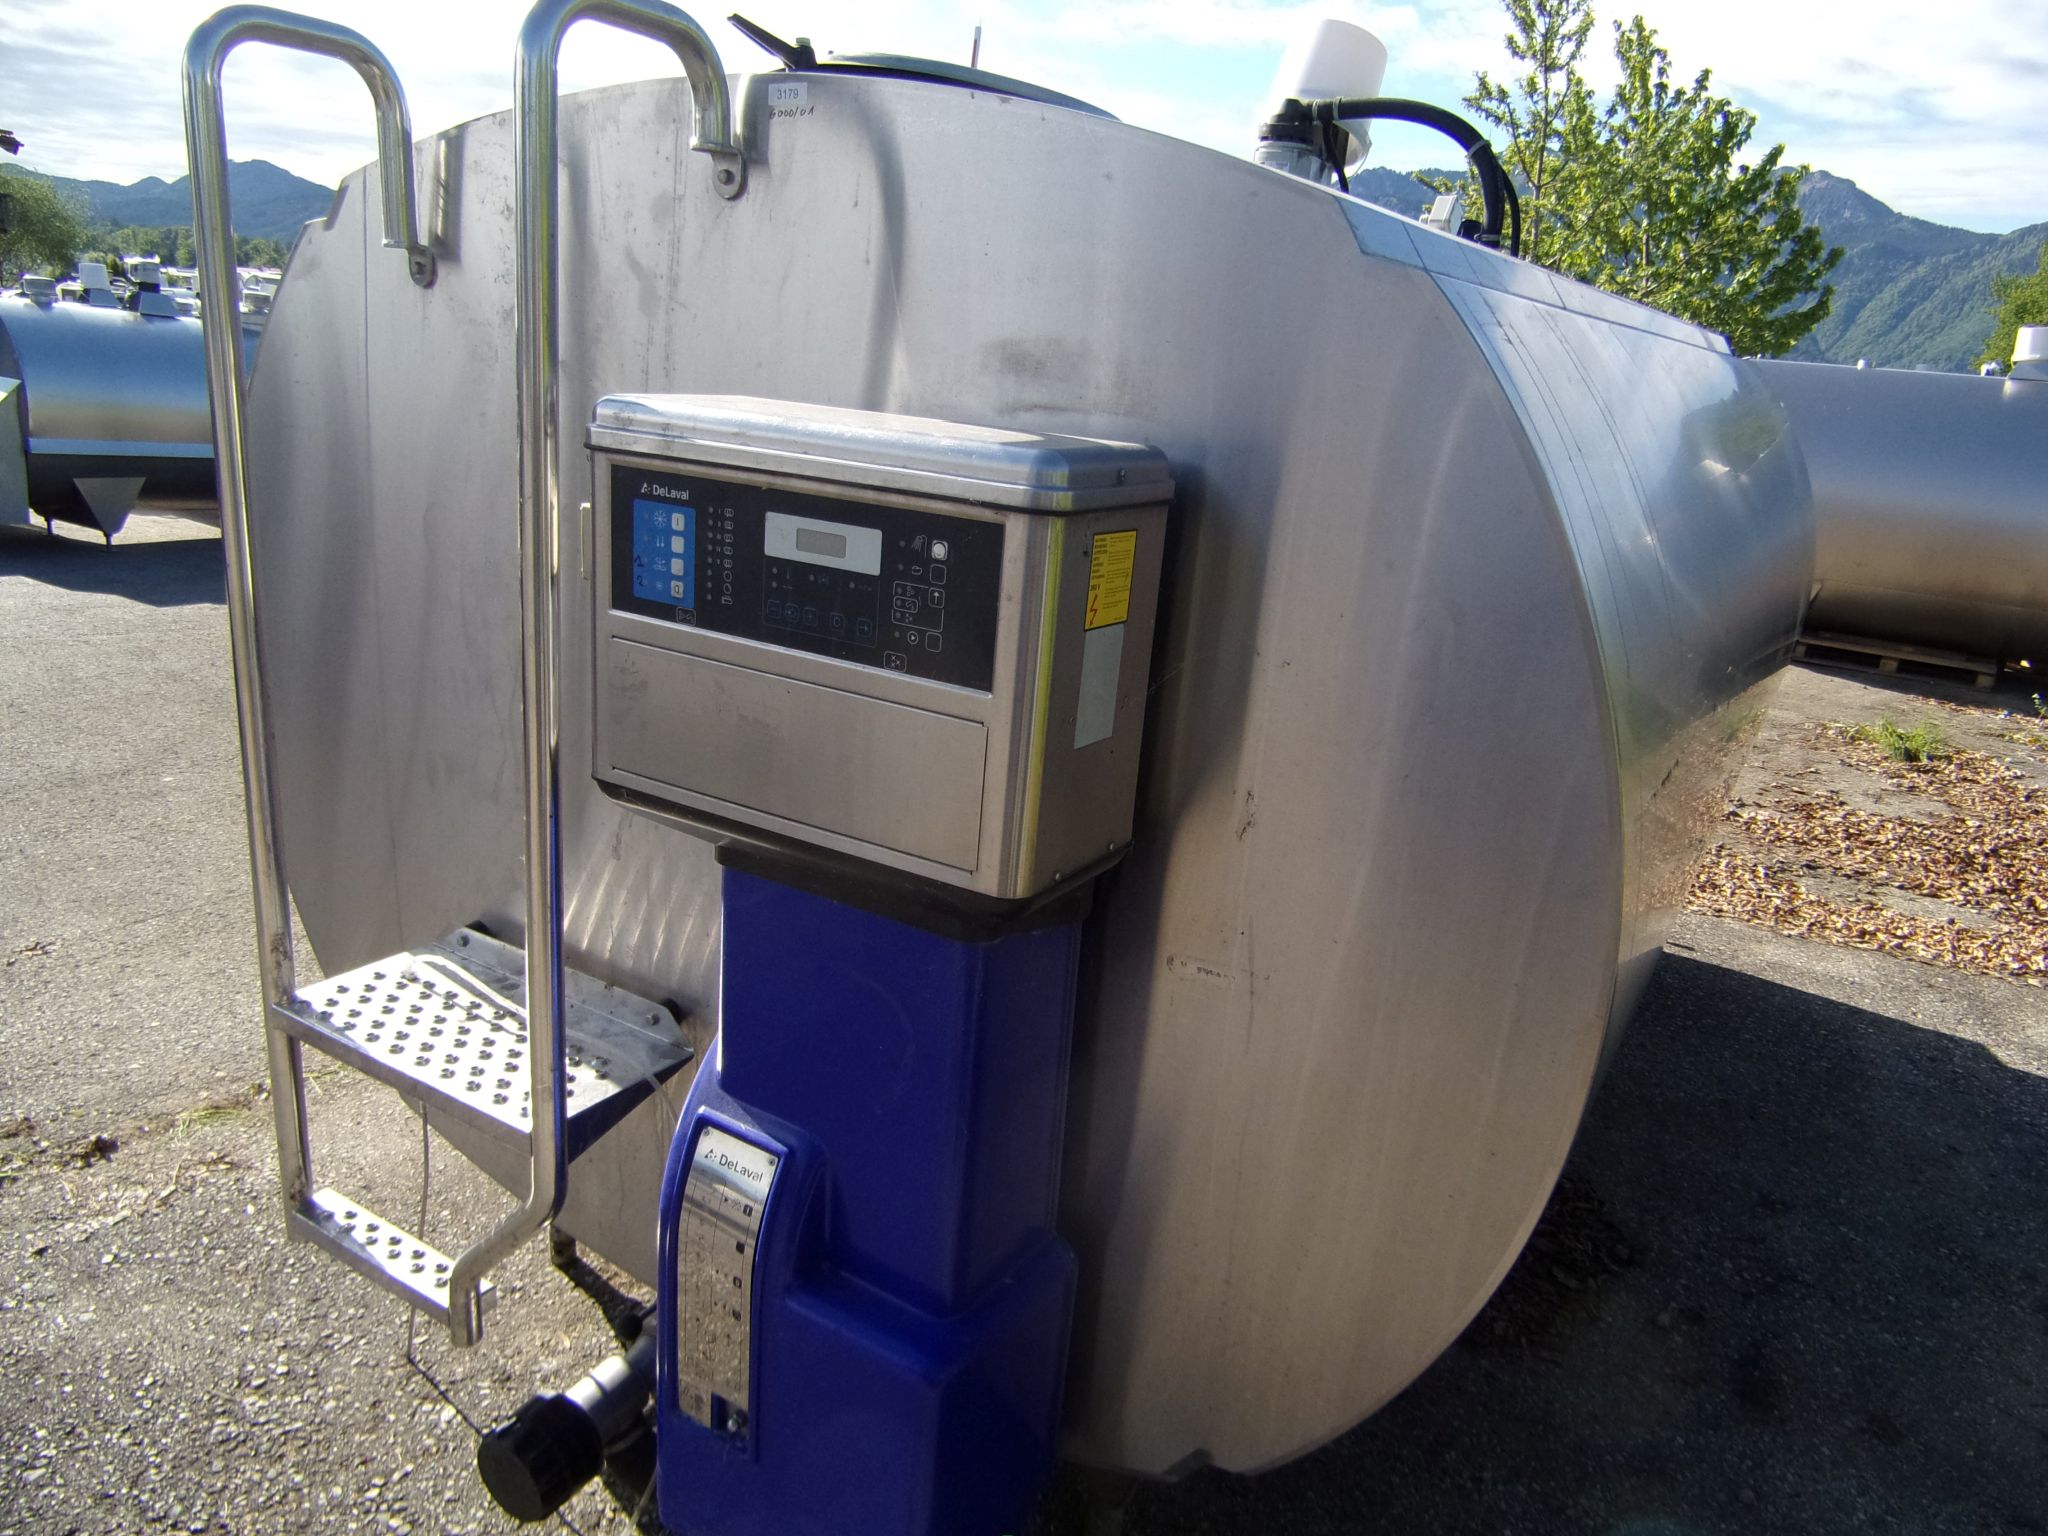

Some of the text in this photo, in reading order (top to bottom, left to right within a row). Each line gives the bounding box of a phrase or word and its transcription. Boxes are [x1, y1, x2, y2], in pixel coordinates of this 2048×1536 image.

[777, 88, 799, 100] 3179
[652, 484, 689, 500] DeLaval
[719, 1153, 764, 1183] DeLaval
